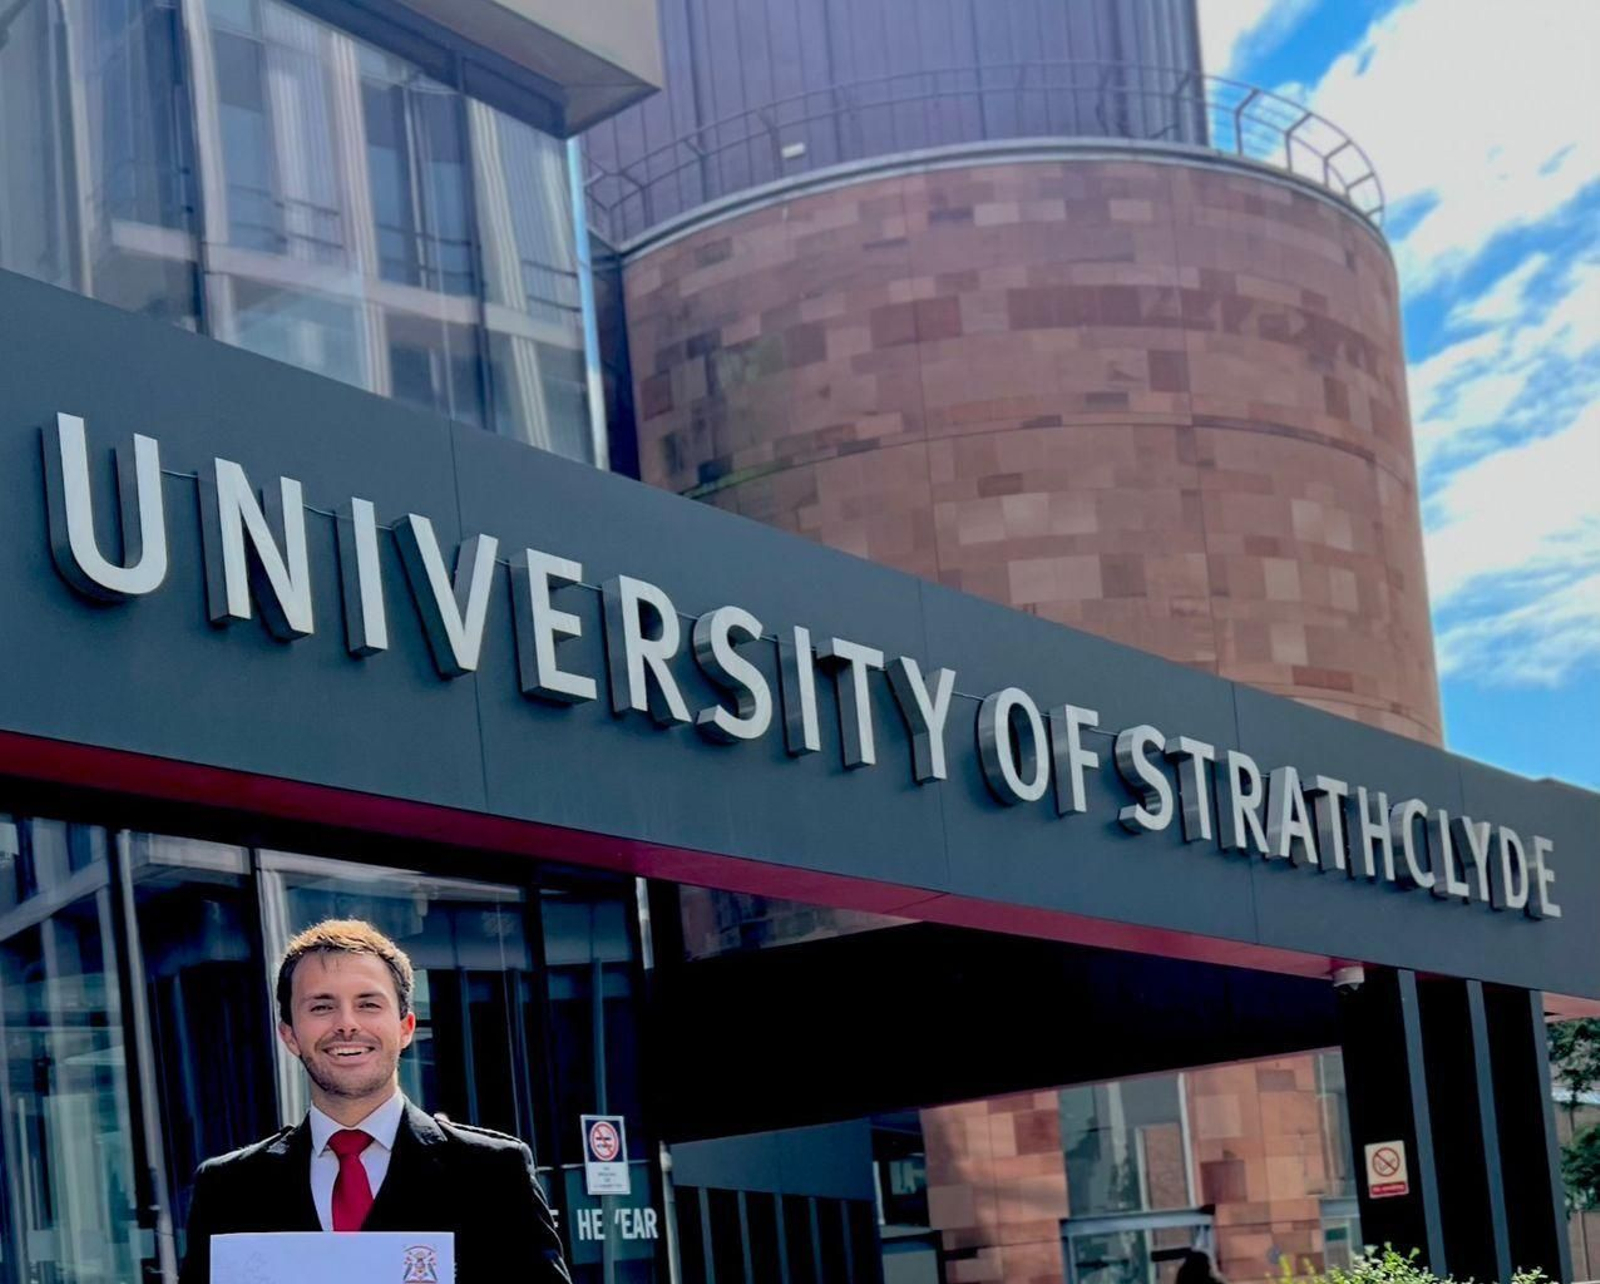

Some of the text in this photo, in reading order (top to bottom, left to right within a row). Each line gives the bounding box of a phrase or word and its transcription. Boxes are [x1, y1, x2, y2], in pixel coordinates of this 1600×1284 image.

[42, 412, 1562, 920] UNIVERSITY OF STRATHCLYDE
